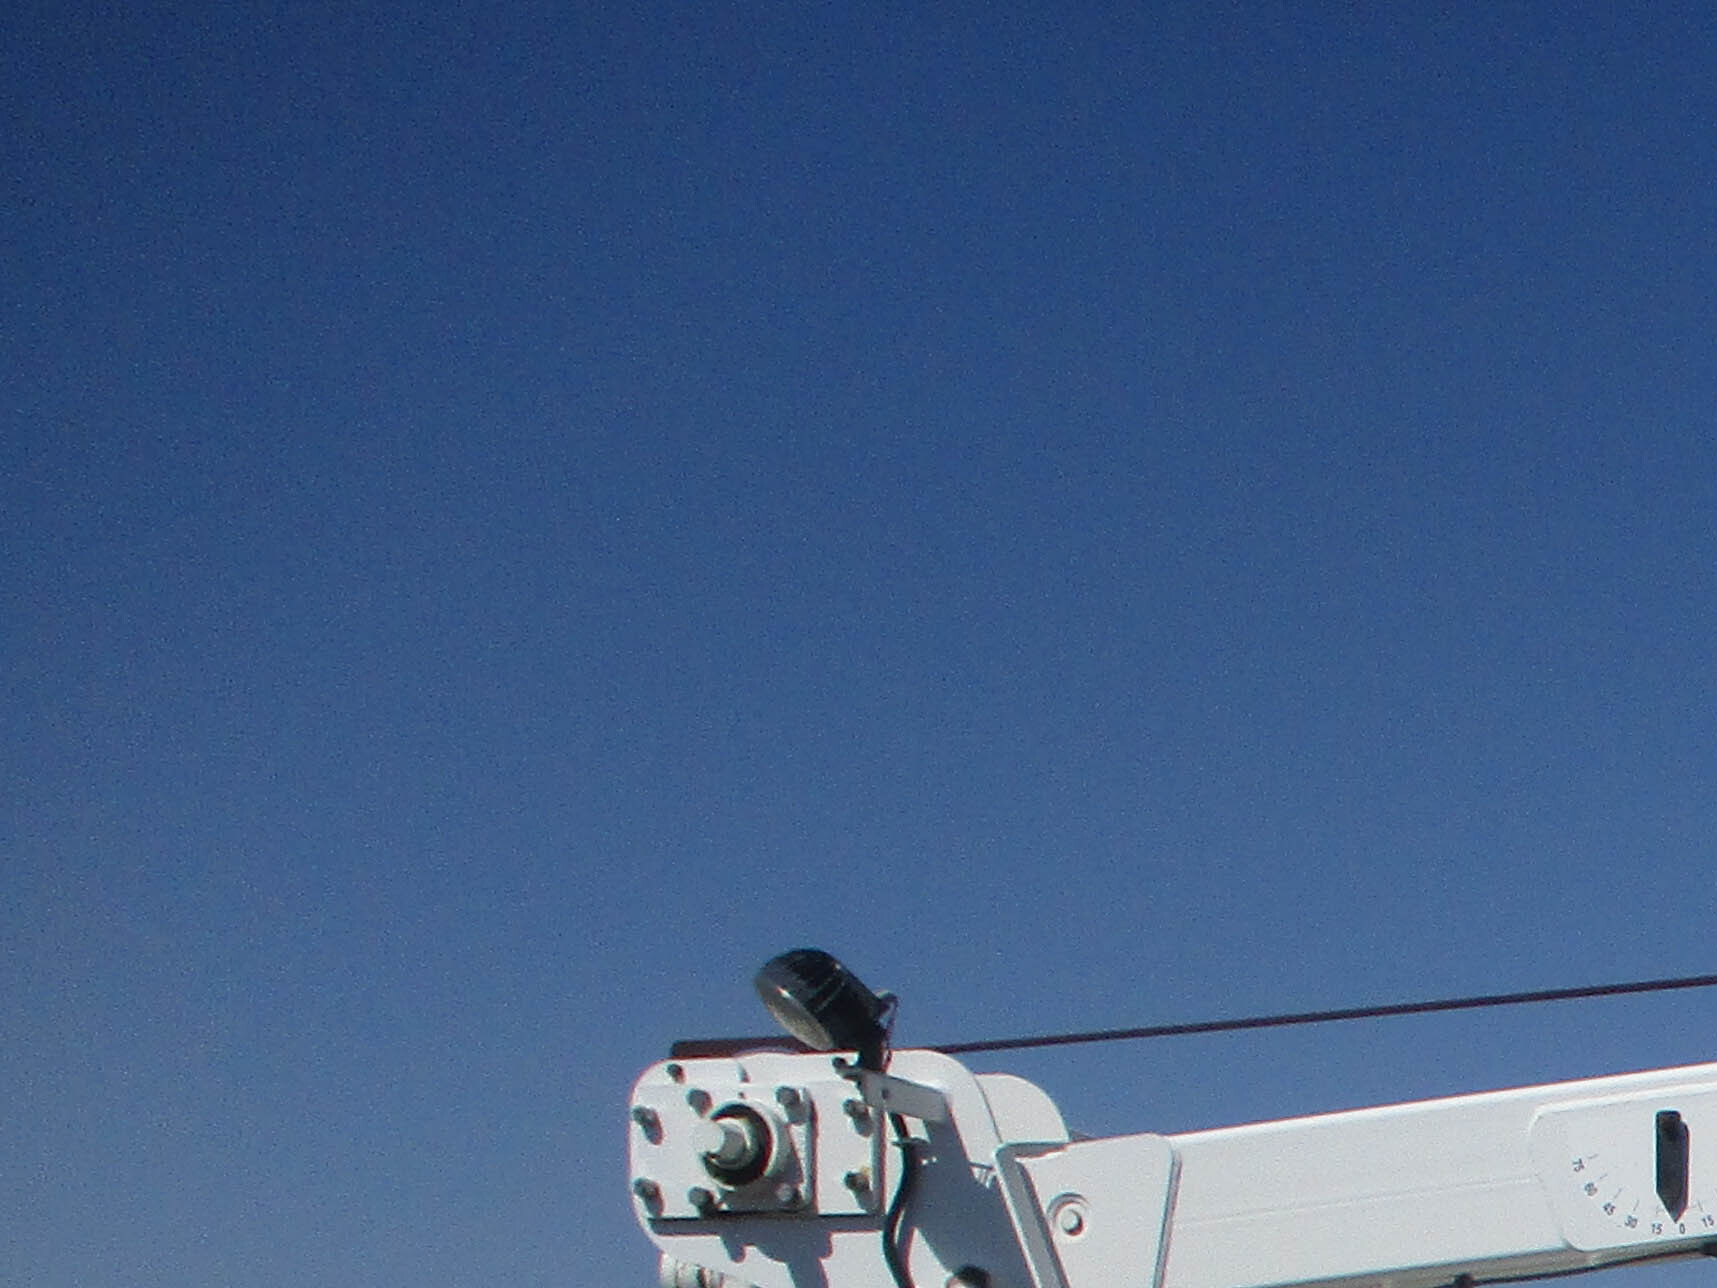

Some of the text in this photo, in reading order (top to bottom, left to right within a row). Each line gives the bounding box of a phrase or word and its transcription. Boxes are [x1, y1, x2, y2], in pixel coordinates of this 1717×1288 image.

[1572, 1158, 1585, 1173] 75
[1702, 1215, 1715, 1228] 15
[1651, 1223, 1663, 1235] 15
[1679, 1224, 1686, 1235] 0
